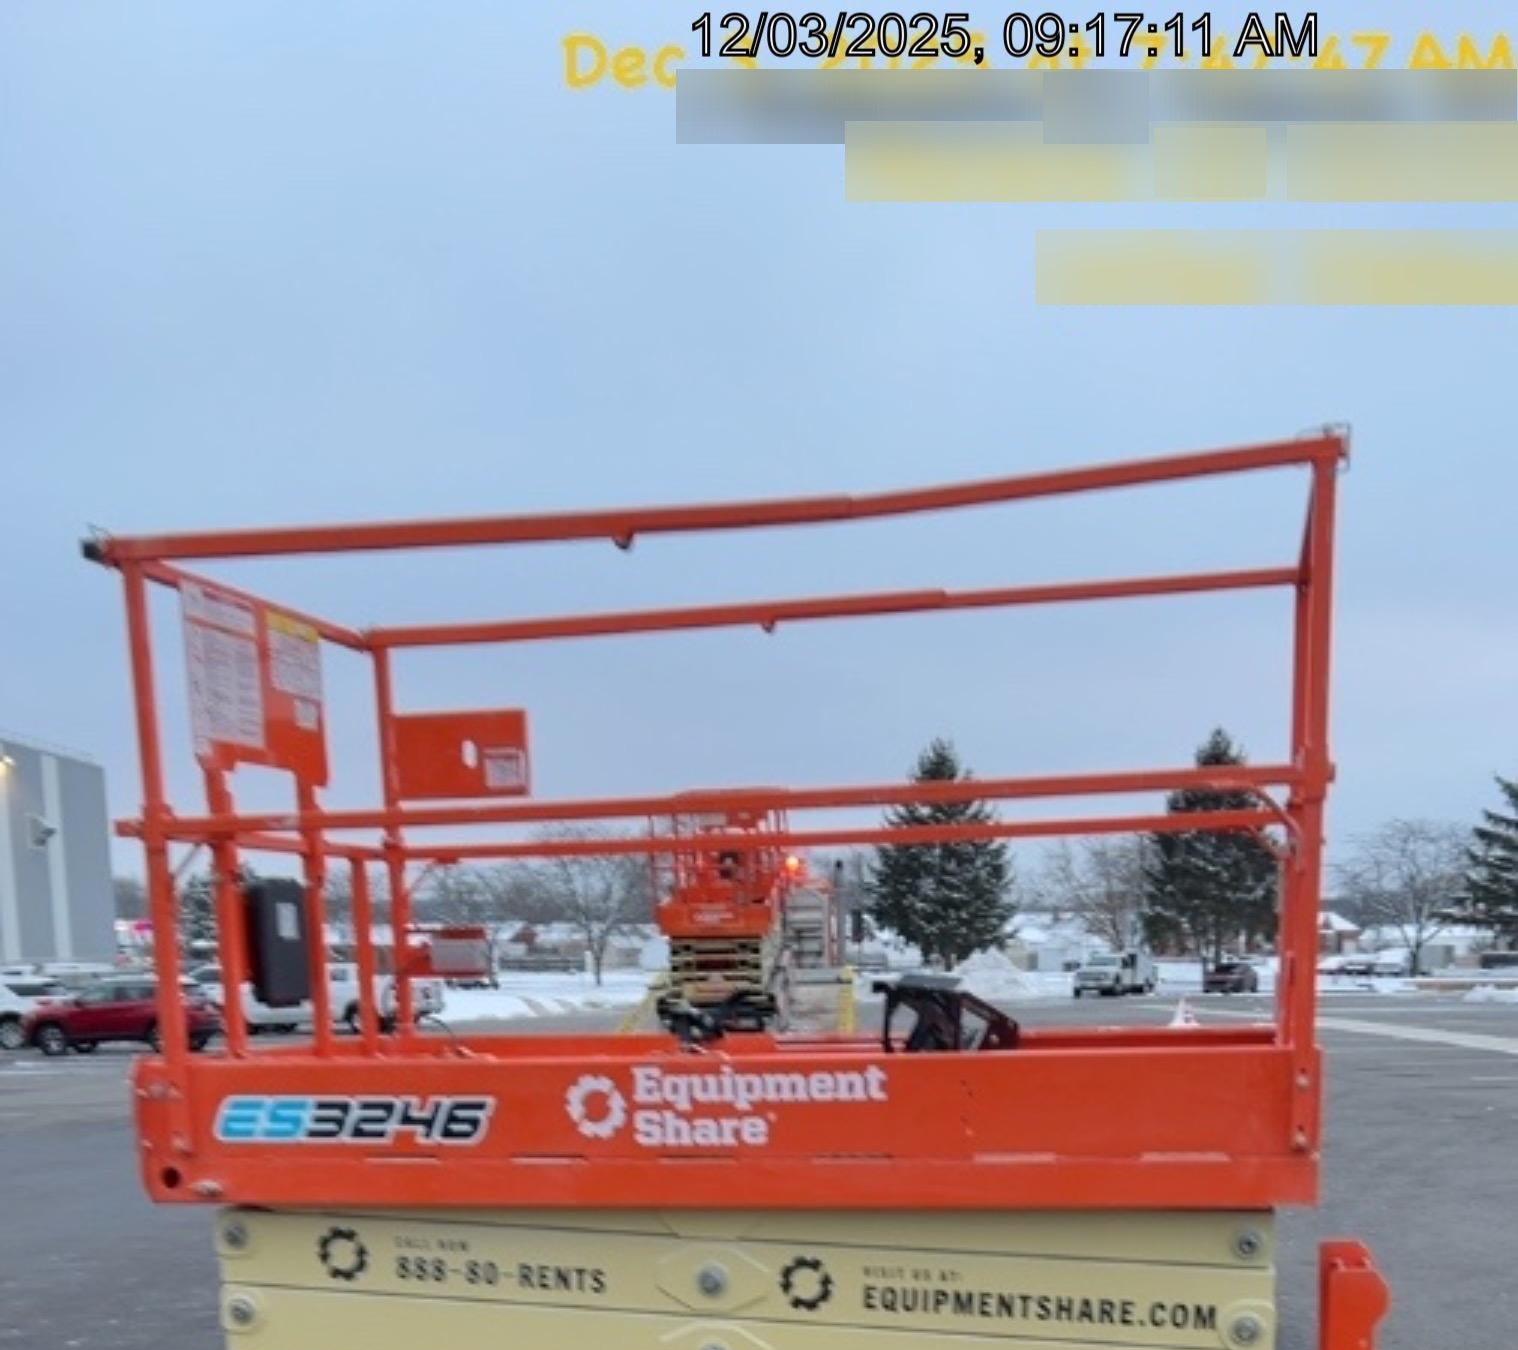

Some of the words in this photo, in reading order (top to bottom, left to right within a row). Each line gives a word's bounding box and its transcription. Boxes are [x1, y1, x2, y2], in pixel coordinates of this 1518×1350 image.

[631, 1064, 888, 1110] Equipment
[214, 1096, 495, 1143] ES3246
[632, 1109, 769, 1146] Share
[396, 1256, 607, 1293] 888-80-RENTS
[862, 1285, 1218, 1331] EQUIPMENTSHARE.COM
